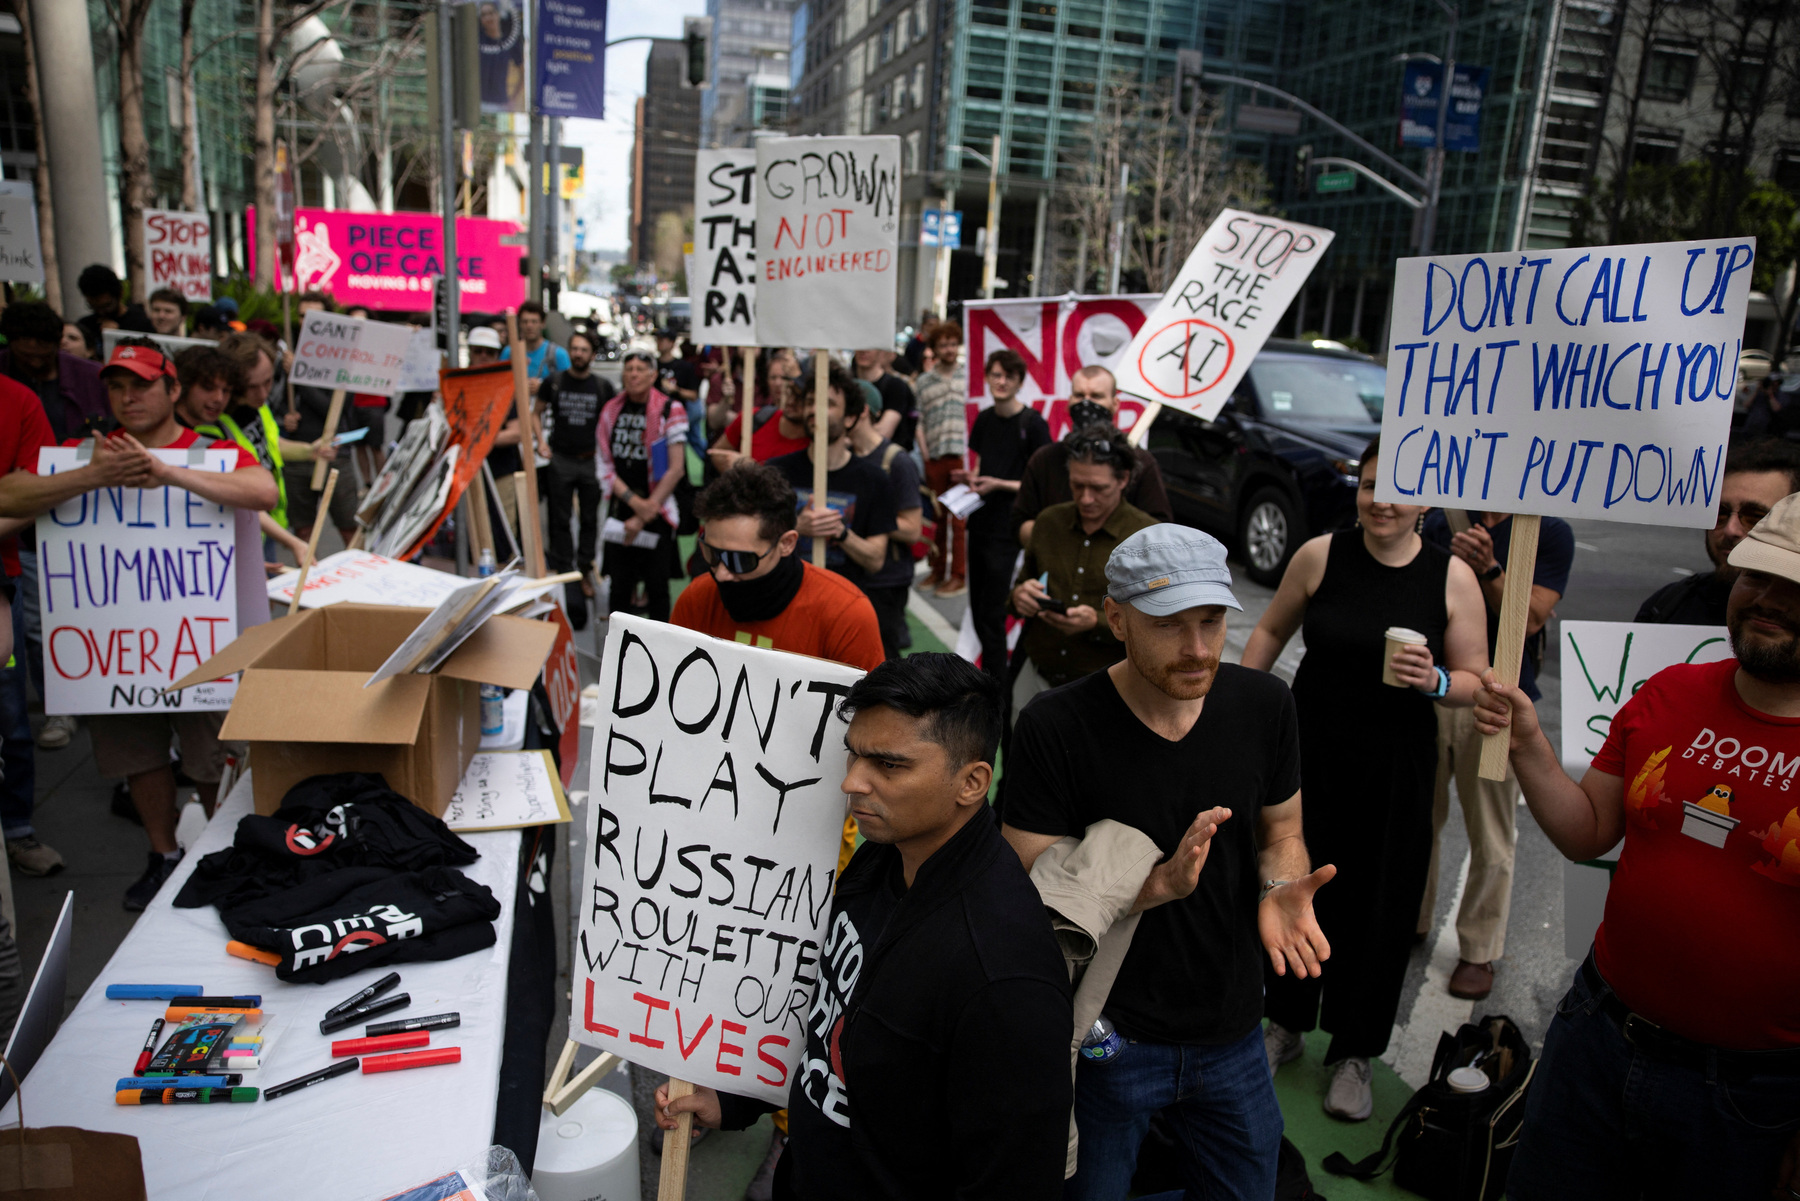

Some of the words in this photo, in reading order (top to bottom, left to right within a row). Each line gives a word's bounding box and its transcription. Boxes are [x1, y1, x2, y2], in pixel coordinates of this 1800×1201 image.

[764, 151, 896, 217] GROWN
[148, 214, 210, 247] STOP
[348, 226, 434, 250] PIECE
[774, 209, 853, 250] NOT
[1213, 216, 1317, 276] STOP
[152, 248, 210, 283] RACING
[348, 275, 405, 291] MOVING
[408, 276, 420, 292] &
[350, 252, 391, 273] OF
[766, 249, 891, 281] ENGINEERED
[1213, 262, 1272, 300] THE
[1172, 280, 1263, 330] RACE
[1421, 255, 1552, 336] DON'T
[1556, 252, 1652, 326] CALL
[1680, 244, 1754, 316] UP
[301, 340, 377, 364] CONTROL
[968, 300, 1148, 397] NO
[1156, 332, 1225, 383] AI
[1394, 340, 1520, 417] THAT
[1532, 341, 1672, 412] WHICH
[1674, 338, 1741, 406] YOU
[1393, 424, 1509, 501] CAN'T
[1518, 435, 1605, 505] PUT
[1602, 442, 1723, 509] DOWN
[42, 540, 235, 613] HUMANITY
[49, 625, 162, 680] OVER
[110, 684, 185, 708] NOW
[611, 628, 853, 764] DON'T
[1681, 747, 1792, 792] DEBATES
[1690, 727, 1800, 779] DOOM
[603, 723, 823, 836] PLAY
[594, 803, 836, 931] RUSSIAN
[592, 877, 820, 986] ROULETTE
[580, 929, 706, 1003] WITH
[734, 975, 809, 1038] OUR
[187, 1029, 222, 1062] POSCA
[584, 976, 791, 1088] LIVES
